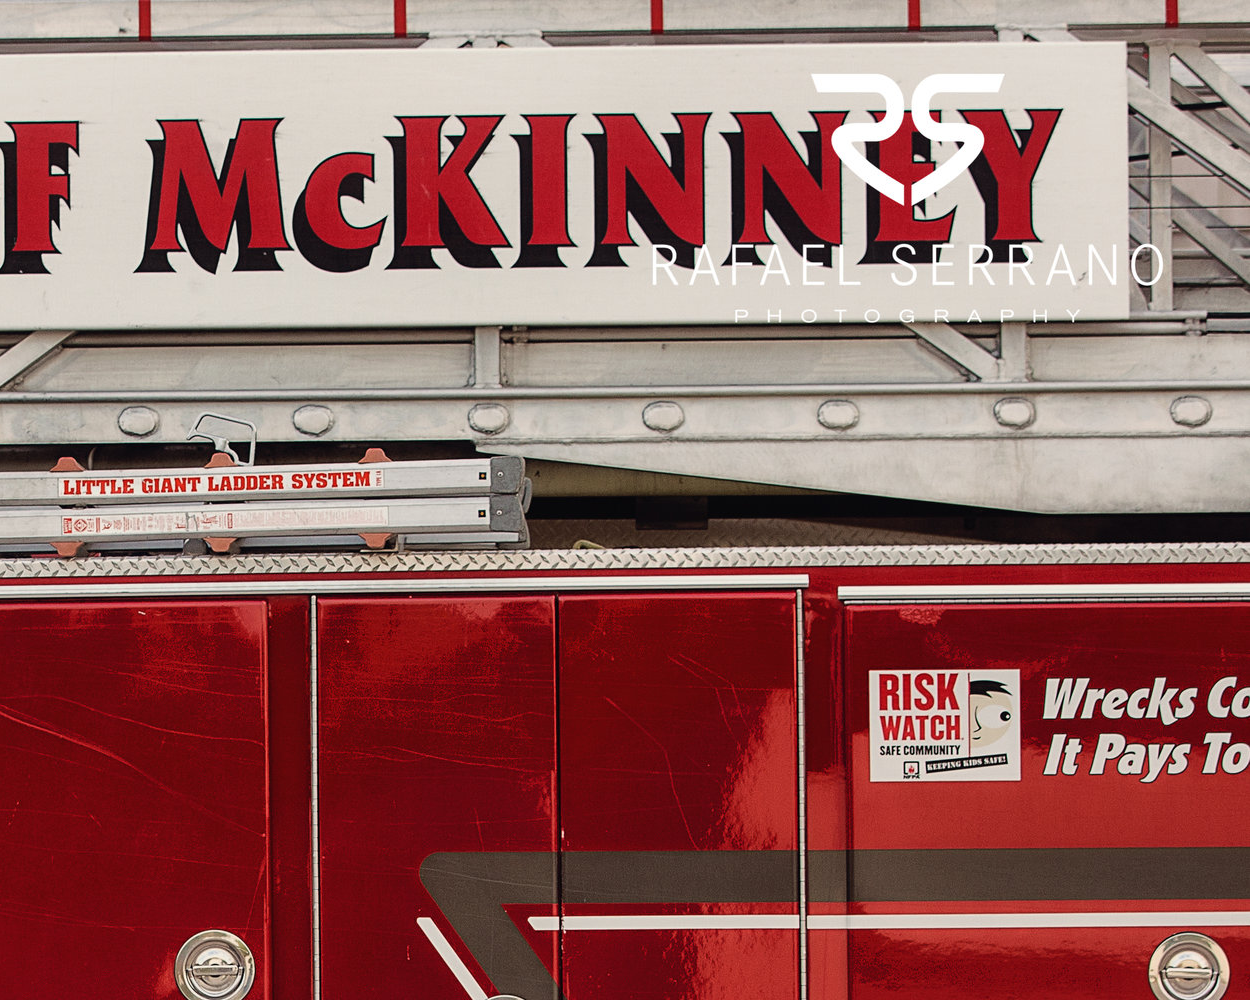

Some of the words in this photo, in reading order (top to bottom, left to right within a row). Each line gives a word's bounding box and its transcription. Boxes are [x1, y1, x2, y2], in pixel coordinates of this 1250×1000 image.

[133, 108, 1063, 275] McKINNEY
[63, 479, 135, 496] LITTLE
[141, 477, 201, 494] GIANT
[208, 474, 285, 492] LADDER
[291, 471, 371, 490] SYSTEM
[878, 672, 960, 711] RISK
[1042, 676, 1199, 726] Wrecks
[879, 714, 961, 741] WATCH
[879, 745, 901, 756] SAFE
[903, 744, 961, 756] COMMUNITY
[927, 760, 962, 771] KEEPING
[963, 758, 983, 769] KIDS
[984, 756, 1007, 766] SAFE!
[1042, 733, 1083, 776] It
[1088, 733, 1192, 784] Pays
[1201, 732, 1250, 775] To
